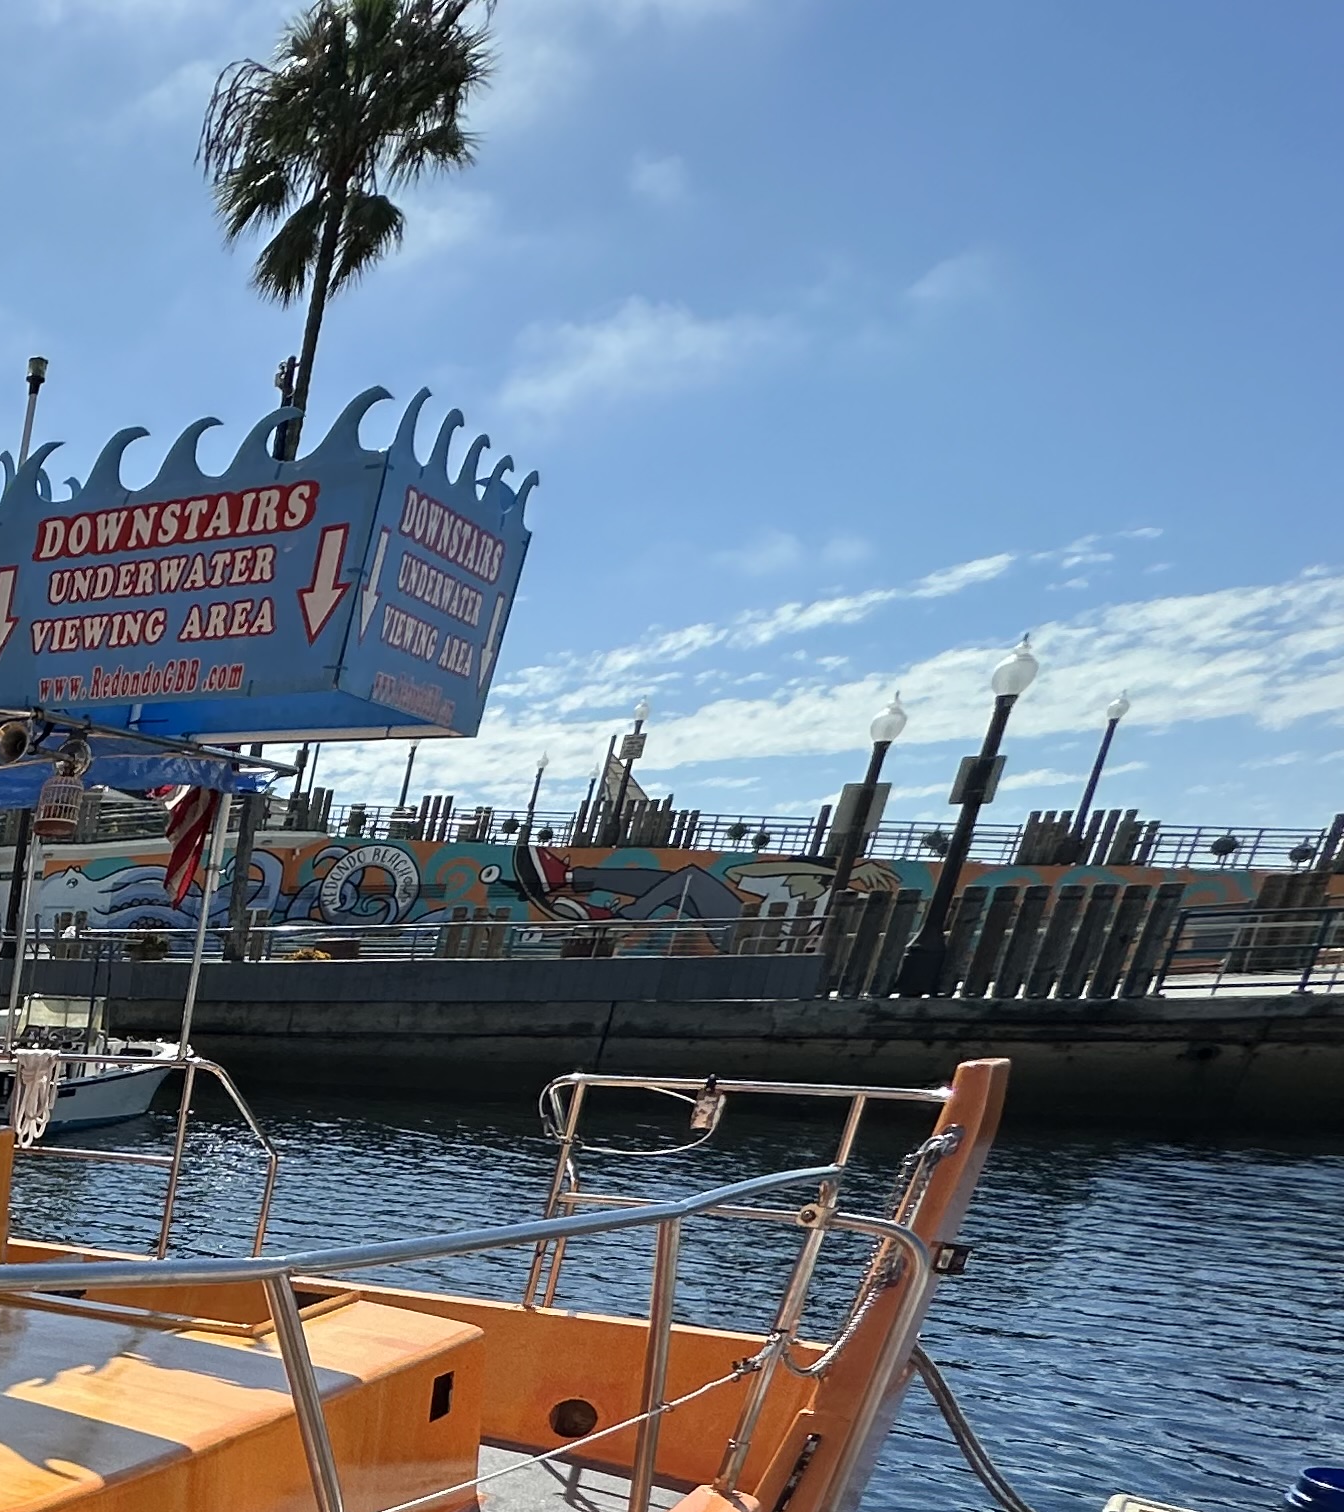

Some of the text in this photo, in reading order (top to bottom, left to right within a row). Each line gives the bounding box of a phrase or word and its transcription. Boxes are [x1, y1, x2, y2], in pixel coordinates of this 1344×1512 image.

[36, 482, 315, 560] DOWNSTAIRS
[400, 487, 504, 583] DOWNSTAIRS
[50, 546, 275, 604] UNDERWATER
[397, 552, 484, 627] UNDERWATER
[32, 598, 275, 653] VIEWING AREA
[380, 604, 474, 678] VIEWING AREA
[322, 848, 413, 906] REDONDO BEACH
